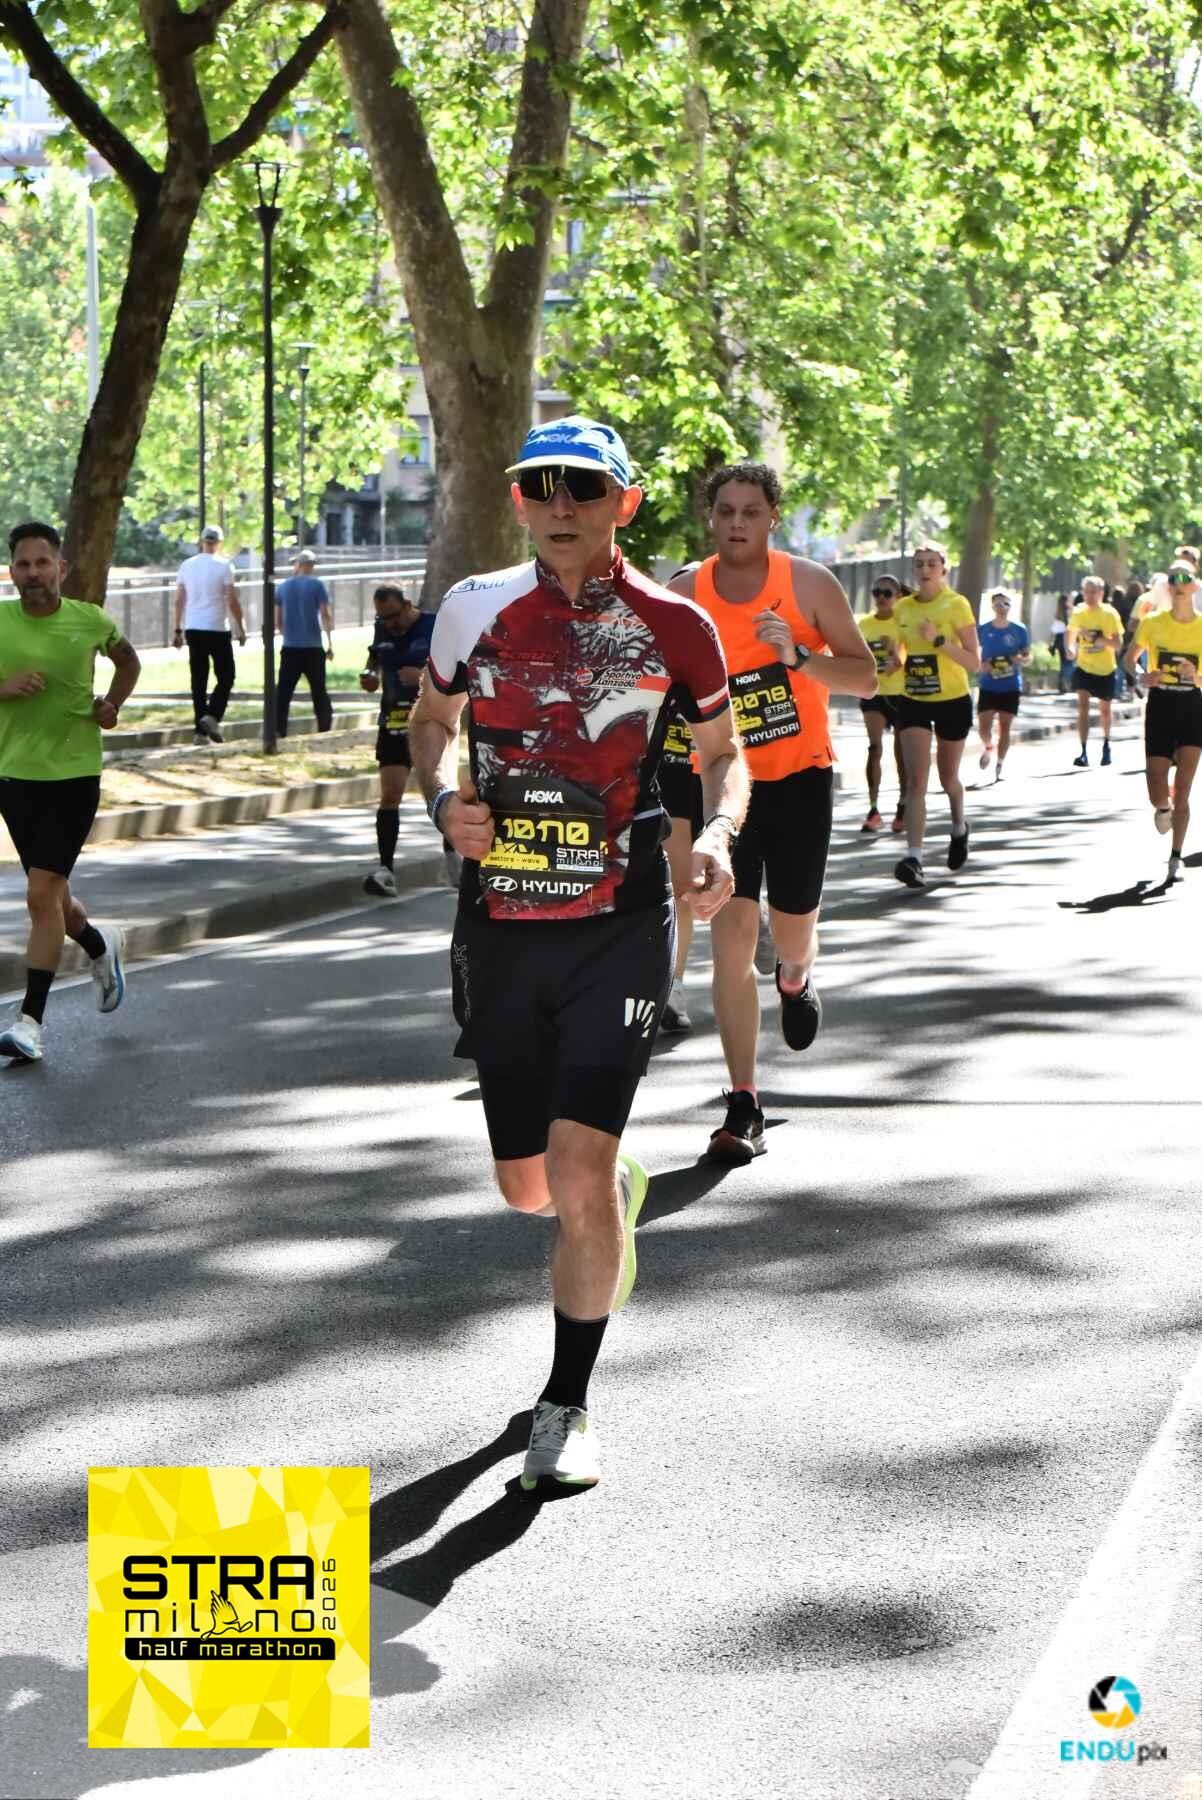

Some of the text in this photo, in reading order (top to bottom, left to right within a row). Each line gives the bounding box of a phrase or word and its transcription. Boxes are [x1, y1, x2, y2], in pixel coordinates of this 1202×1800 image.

[735, 672, 762, 686] HOKA
[750, 722, 800, 743] HYUNDAI
[523, 789, 565, 804] HOKA
[556, 847, 600, 860] STRA
